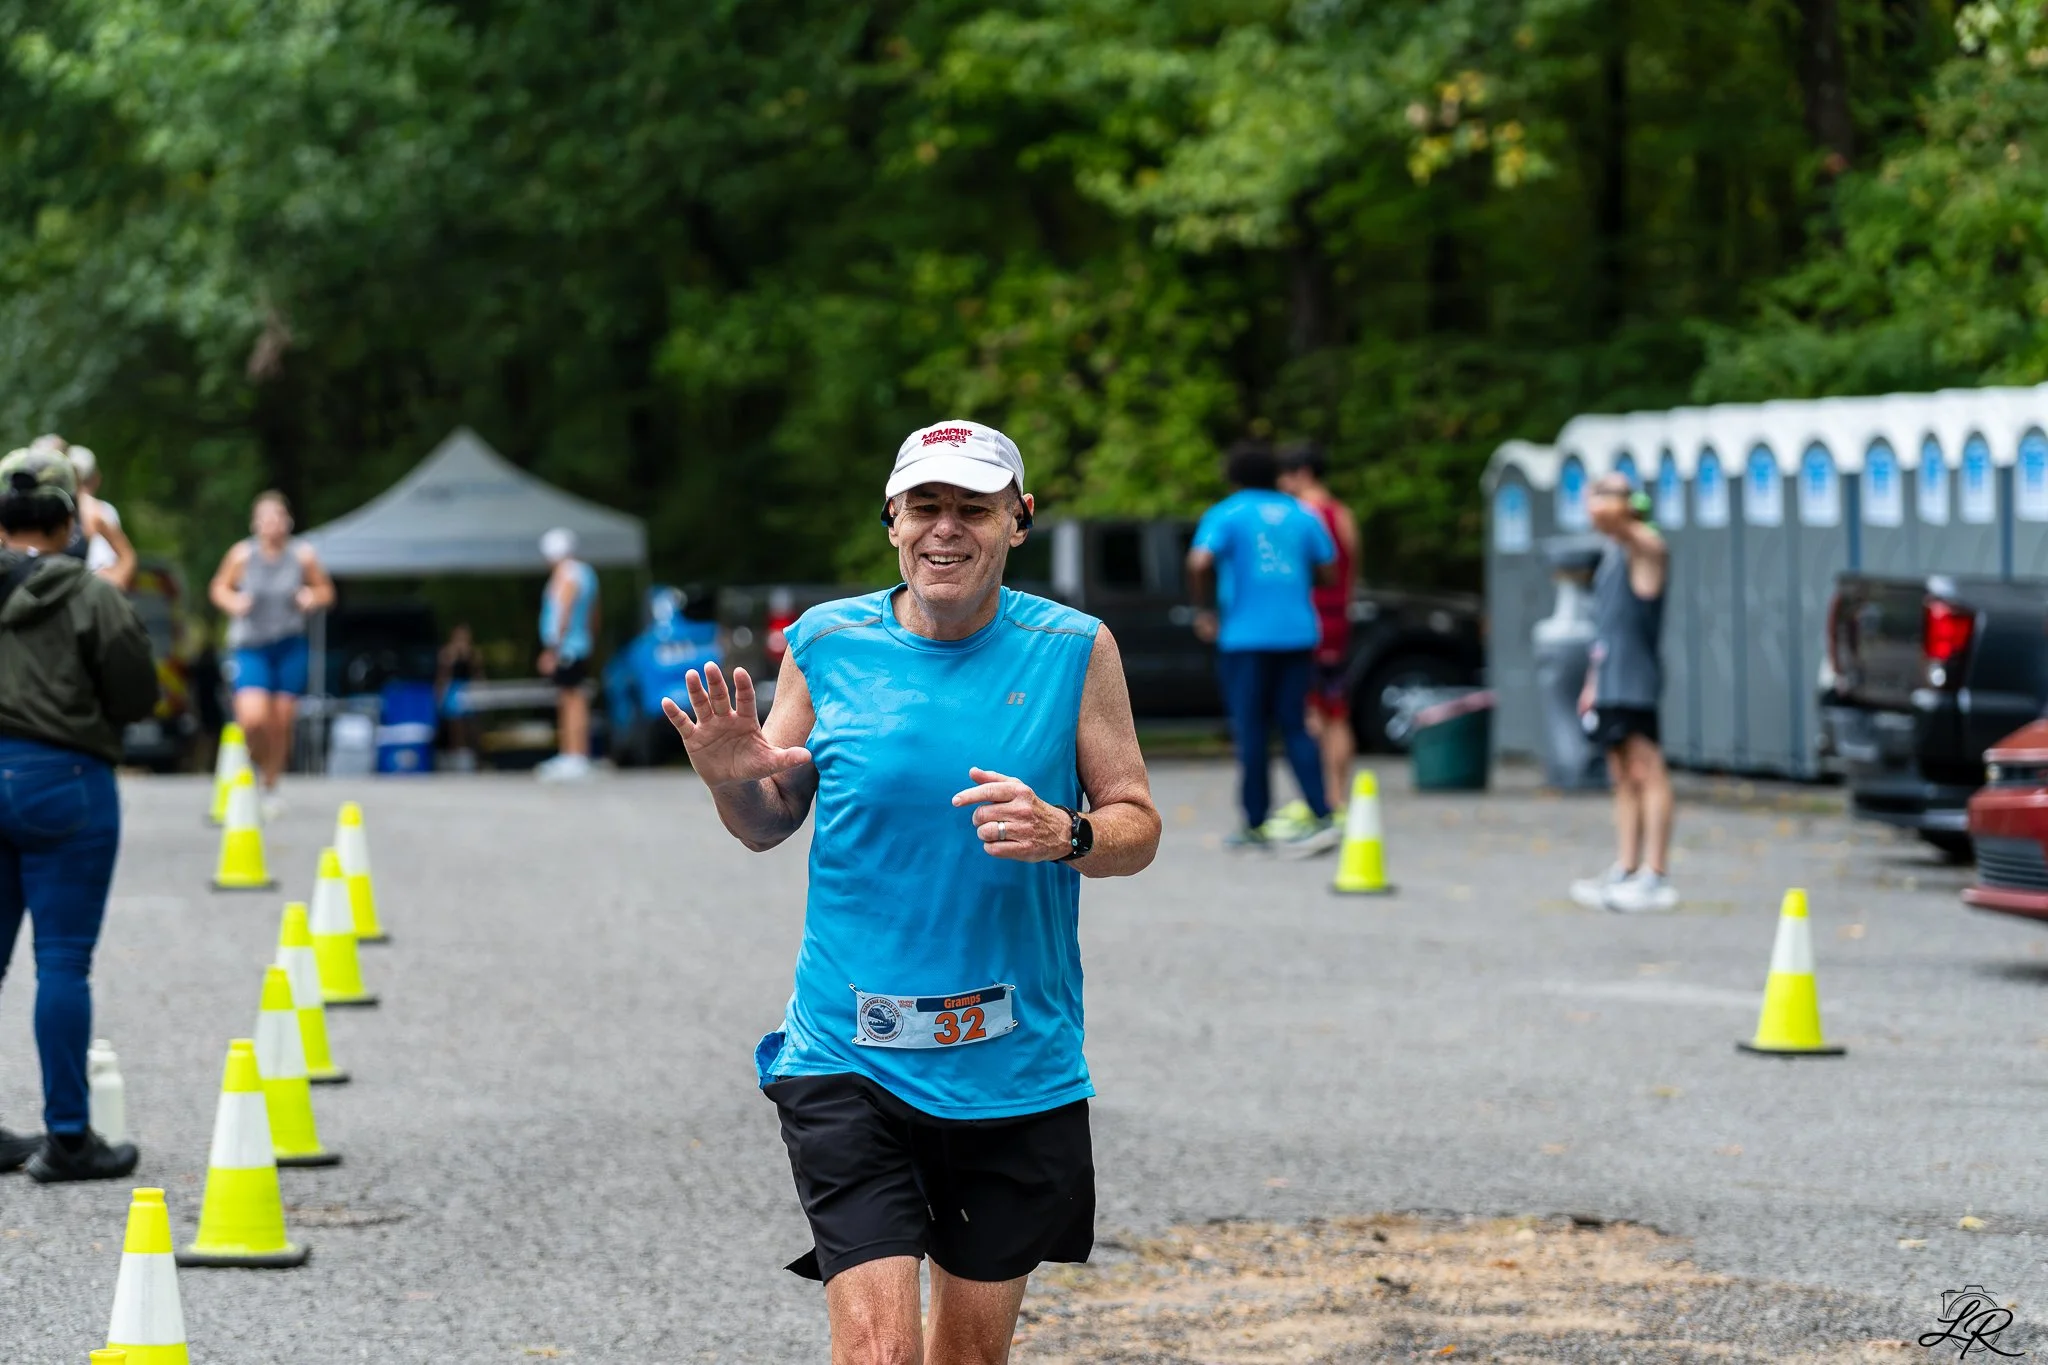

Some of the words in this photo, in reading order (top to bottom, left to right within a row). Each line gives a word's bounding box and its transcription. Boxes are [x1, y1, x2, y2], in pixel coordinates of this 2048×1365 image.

[921, 427, 972, 440] MEMPHIS
[922, 435, 966, 446] RUNNERS
[943, 994, 980, 1009] Gramps
[933, 1007, 986, 1045] 32
